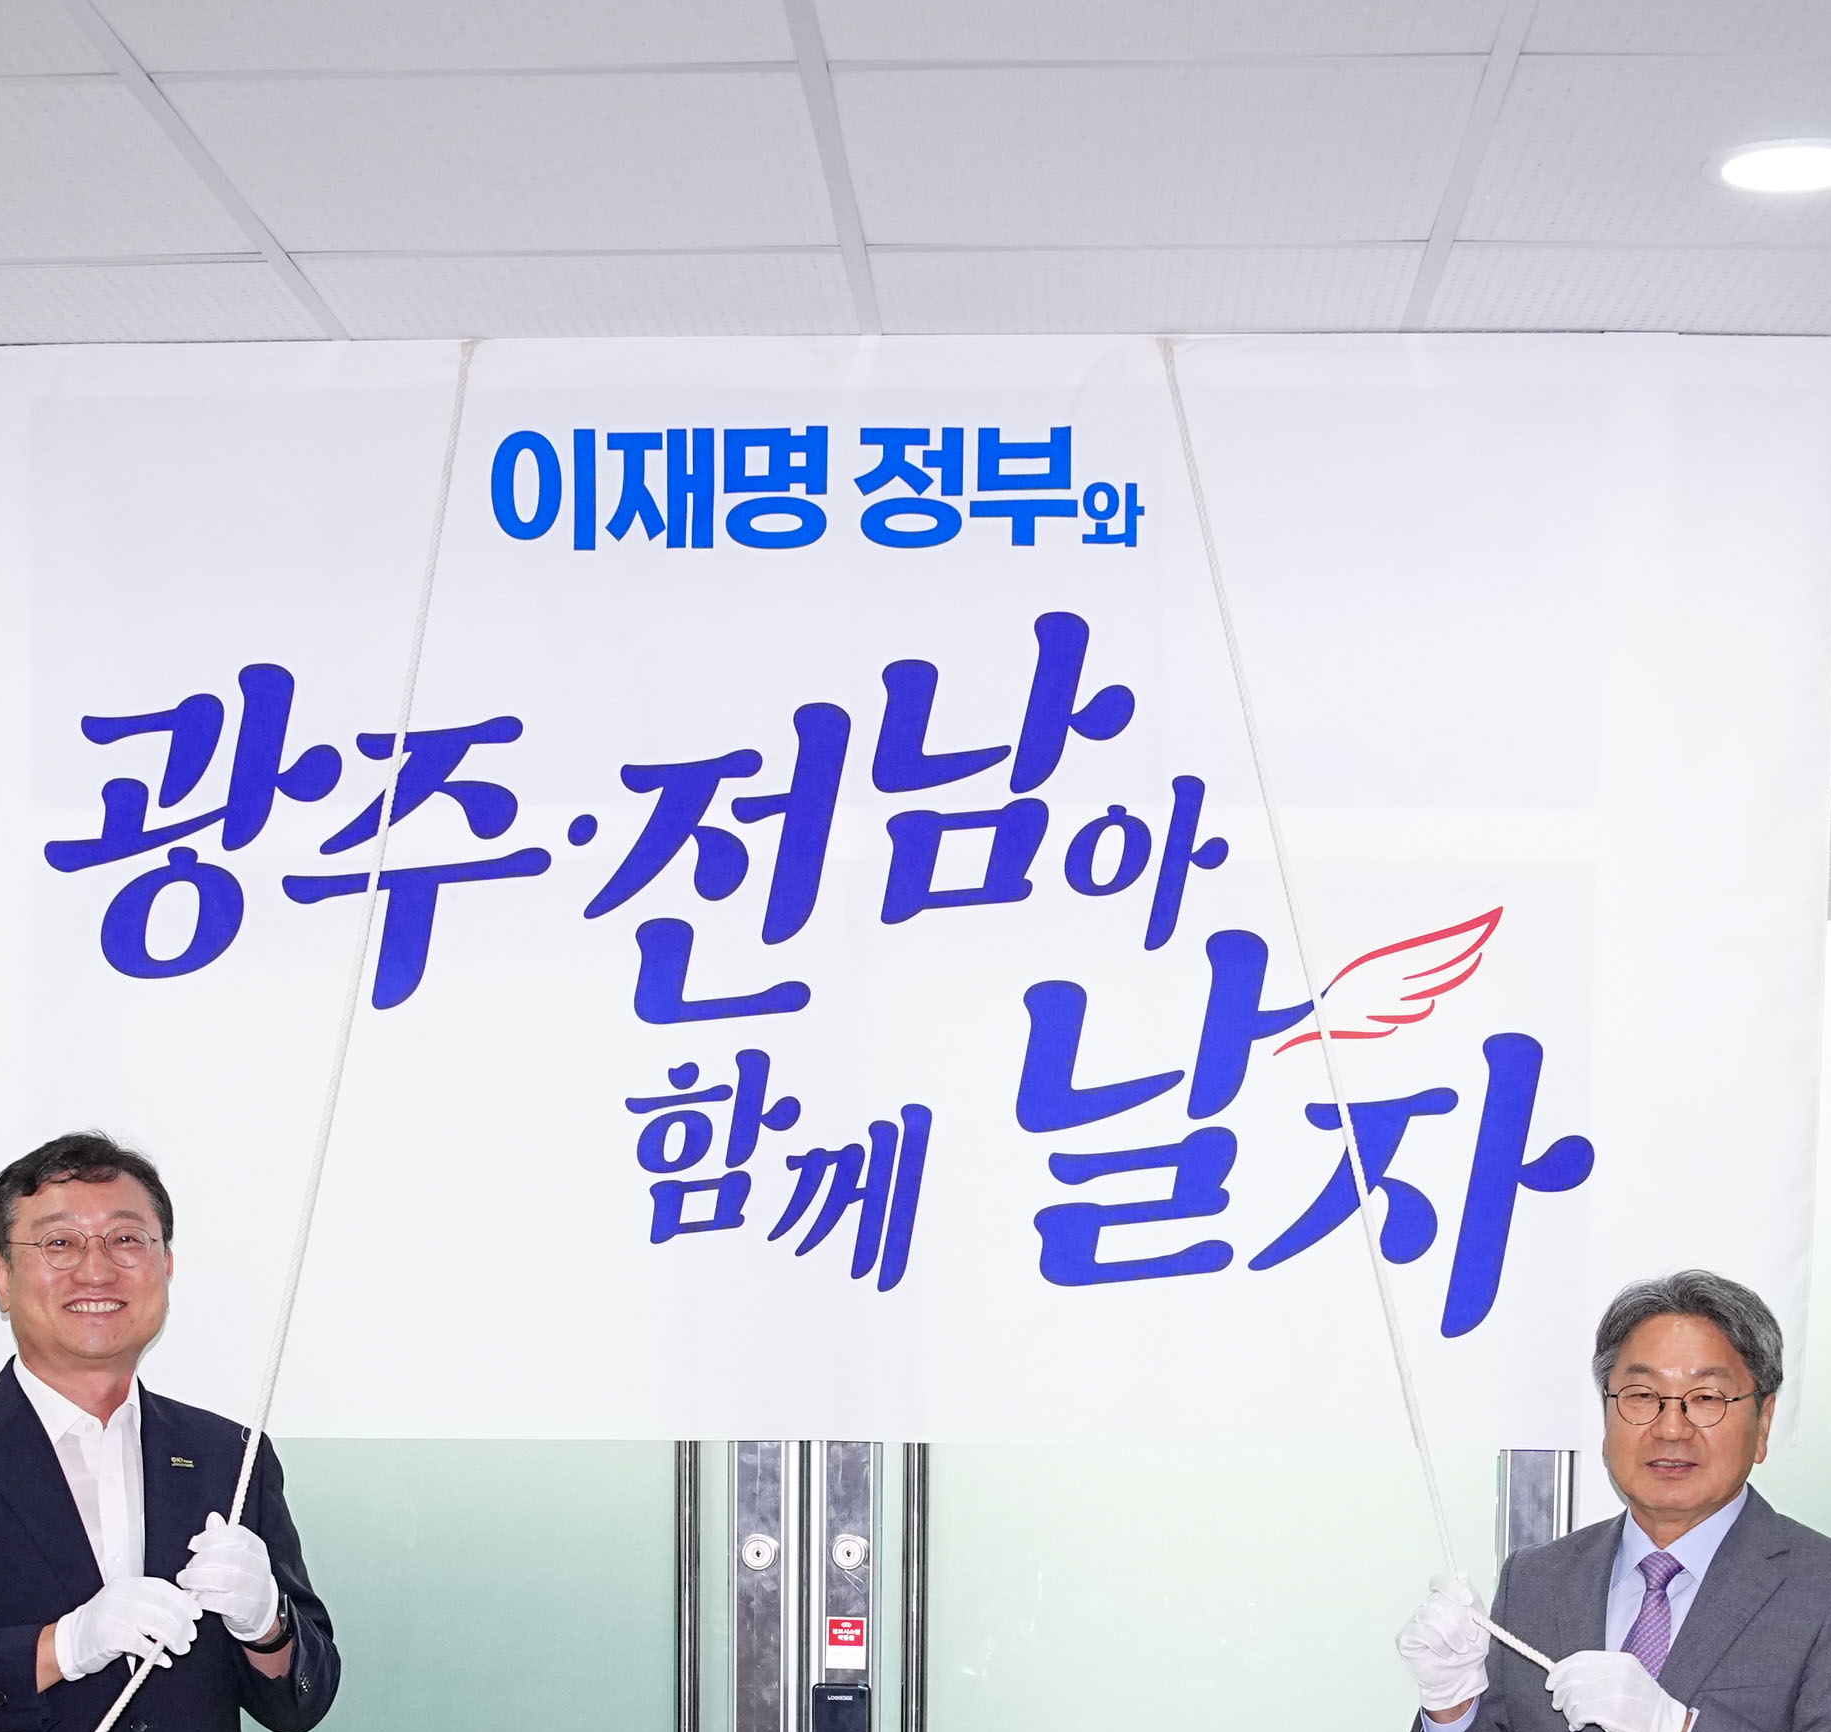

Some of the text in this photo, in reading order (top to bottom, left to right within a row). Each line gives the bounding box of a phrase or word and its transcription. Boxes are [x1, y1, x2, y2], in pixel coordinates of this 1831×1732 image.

[491, 426, 1145, 551] 이재명 정부와
[625, 929, 1595, 1338] 함께 날자
